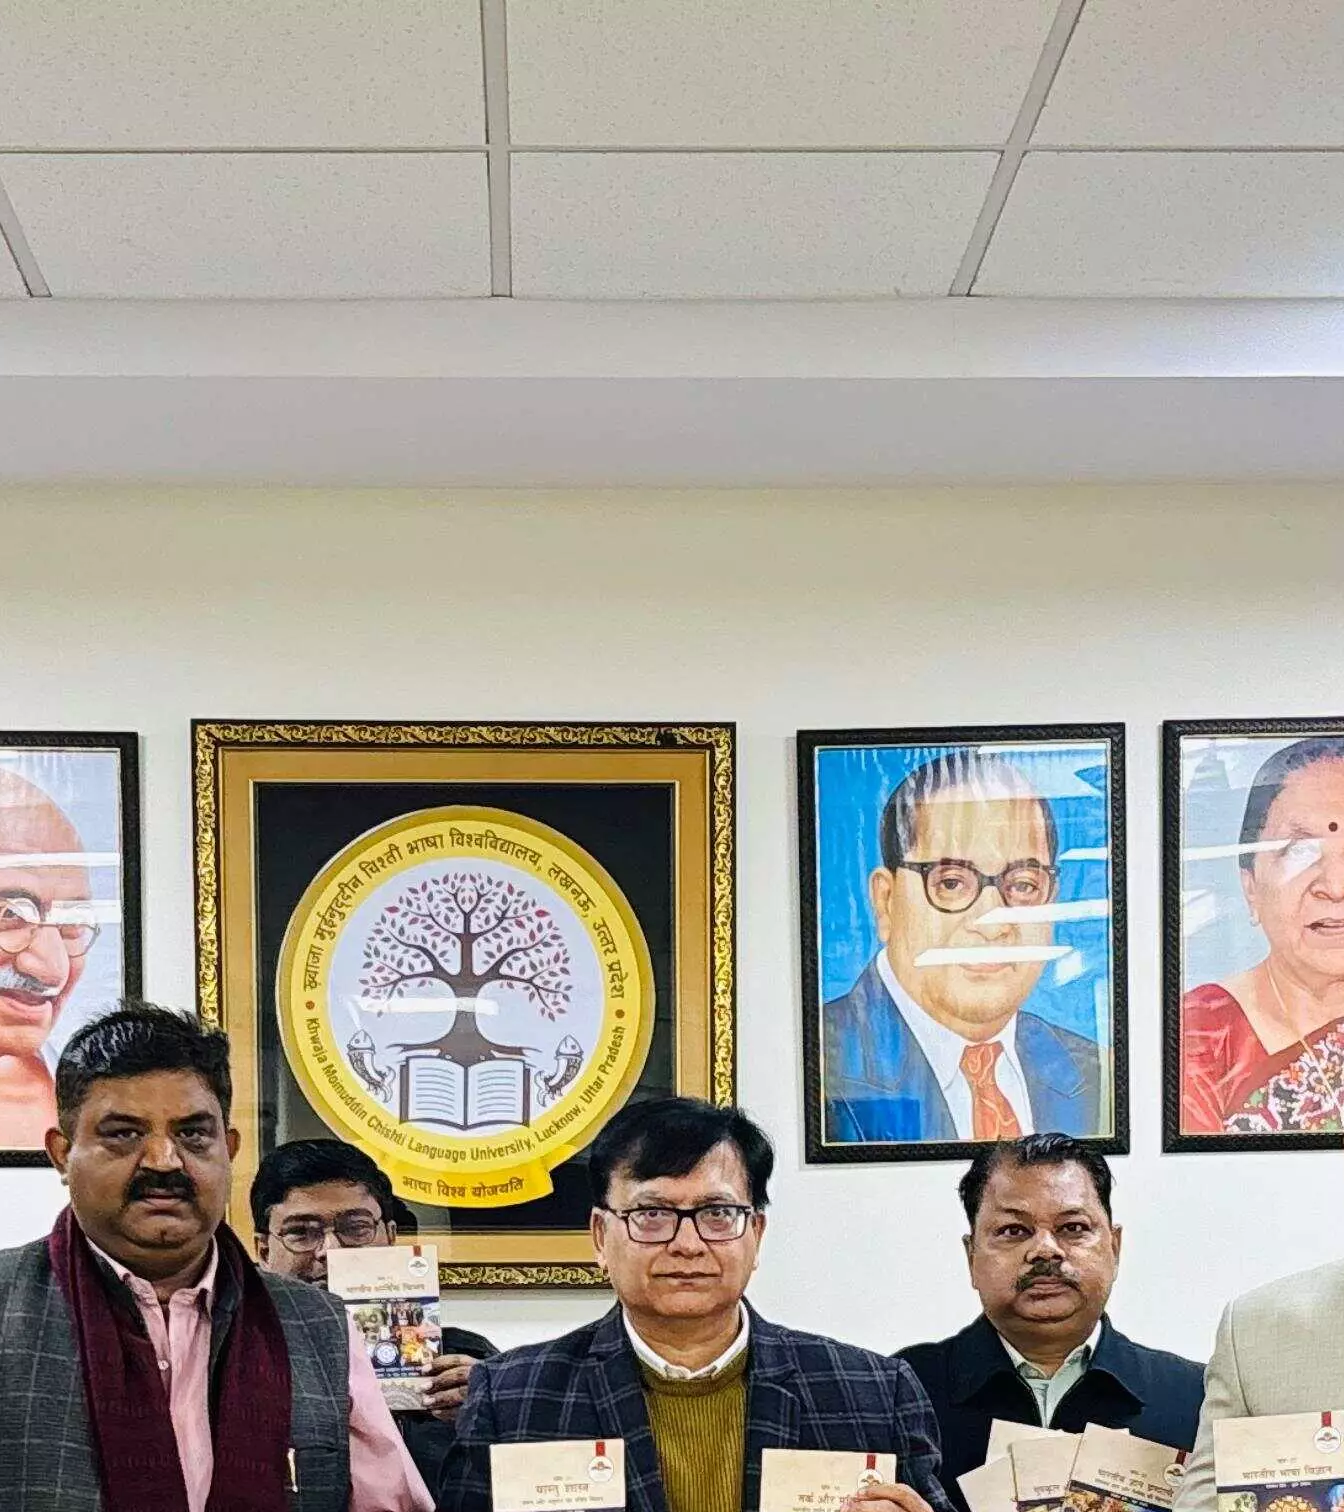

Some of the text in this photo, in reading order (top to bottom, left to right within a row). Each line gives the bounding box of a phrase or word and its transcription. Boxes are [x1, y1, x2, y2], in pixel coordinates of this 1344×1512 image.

[358, 843, 404, 879] चिश्ती
[406, 833, 444, 855] भाषा
[449, 827, 543, 872] विश्वविद्यालय,
[548, 862, 597, 918] लखनऊ,
[593, 917, 618, 957] उत्तर
[606, 960, 628, 999] प्रदेश
[306, 1017, 626, 1163] Khwaja Moinuddin Chishti Language University, Lucknow, Uttar Pradesh
